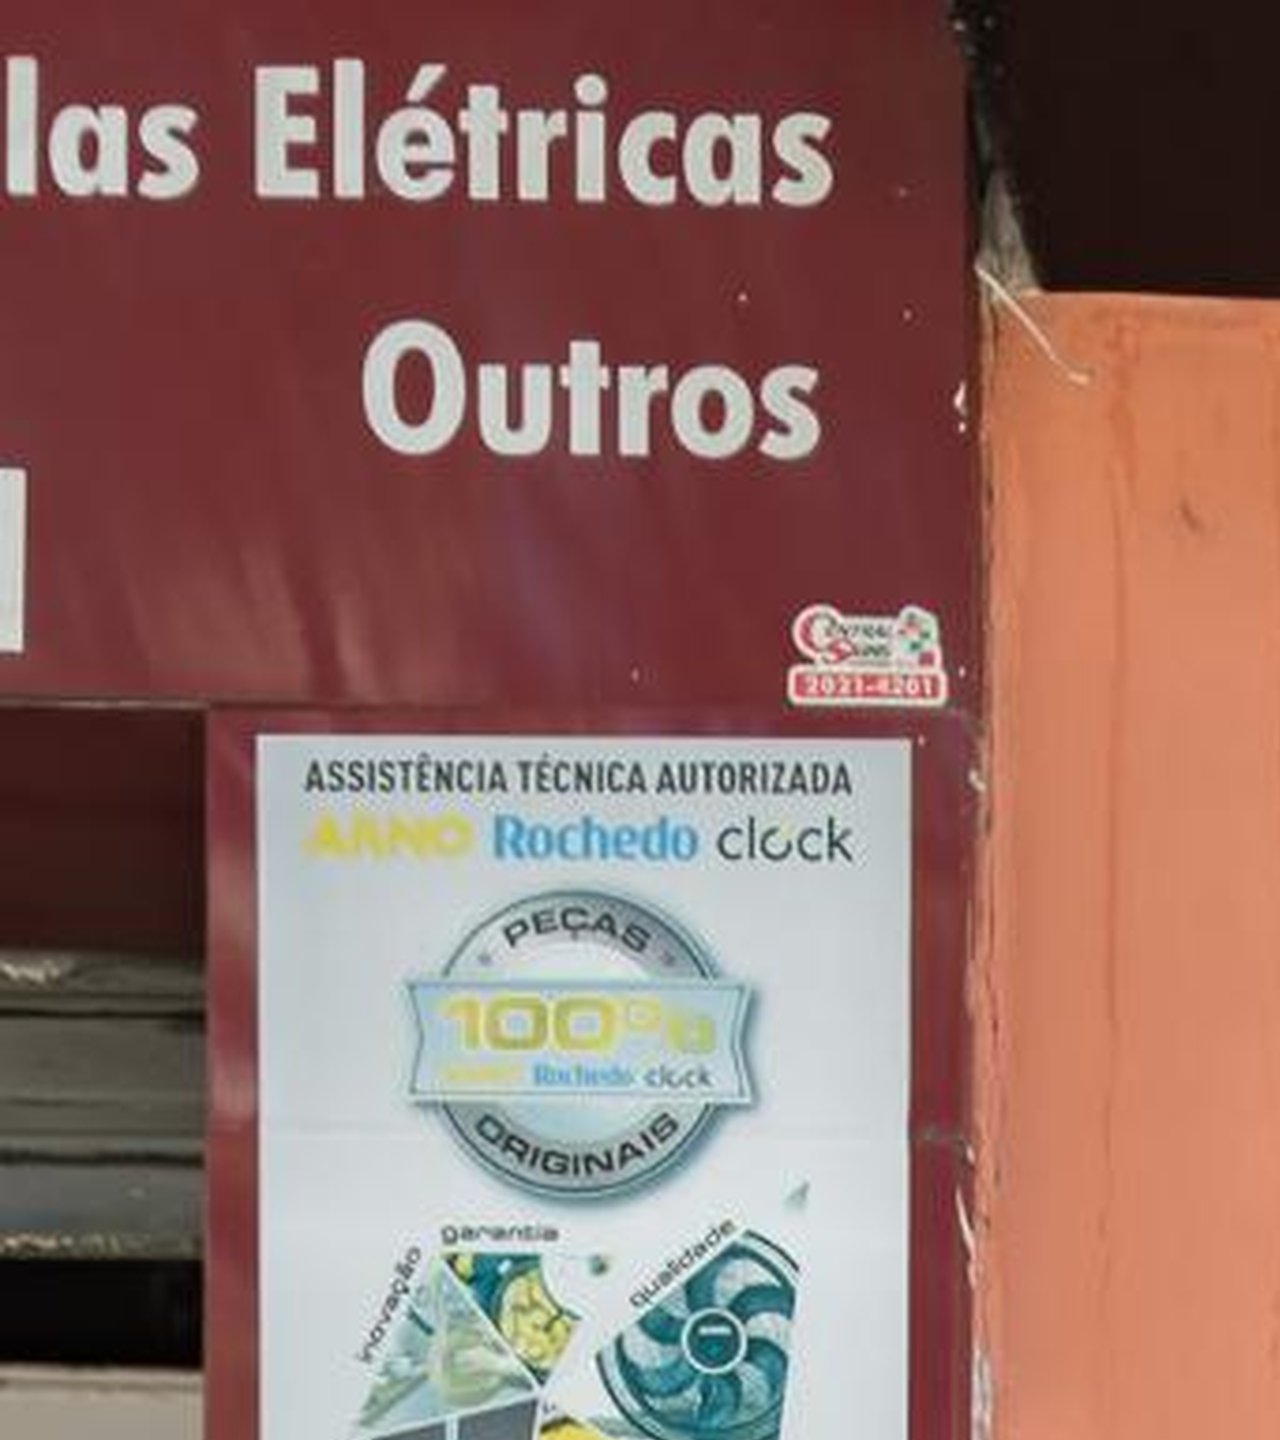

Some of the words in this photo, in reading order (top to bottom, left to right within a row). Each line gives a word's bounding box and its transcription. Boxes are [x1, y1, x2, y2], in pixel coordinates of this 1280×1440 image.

[5, 55, 199, 200] las
[254, 57, 834, 207] Elétricas
[361, 317, 822, 461] Outros
[304, 752, 508, 794] ASSISTÊNCIA
[518, 752, 648, 795] TÉCNICA
[656, 759, 854, 796] AUTORIZADA
[493, 813, 698, 861] Rochedo
[502, 906, 655, 955] PEÇAS
[440, 994, 716, 1055] 100%
[475, 1111, 680, 1178] ORIGINAIS
[441, 1222, 560, 1245] garantia
[629, 1217, 737, 1308] qualidade
[357, 1245, 423, 1364] inovação
